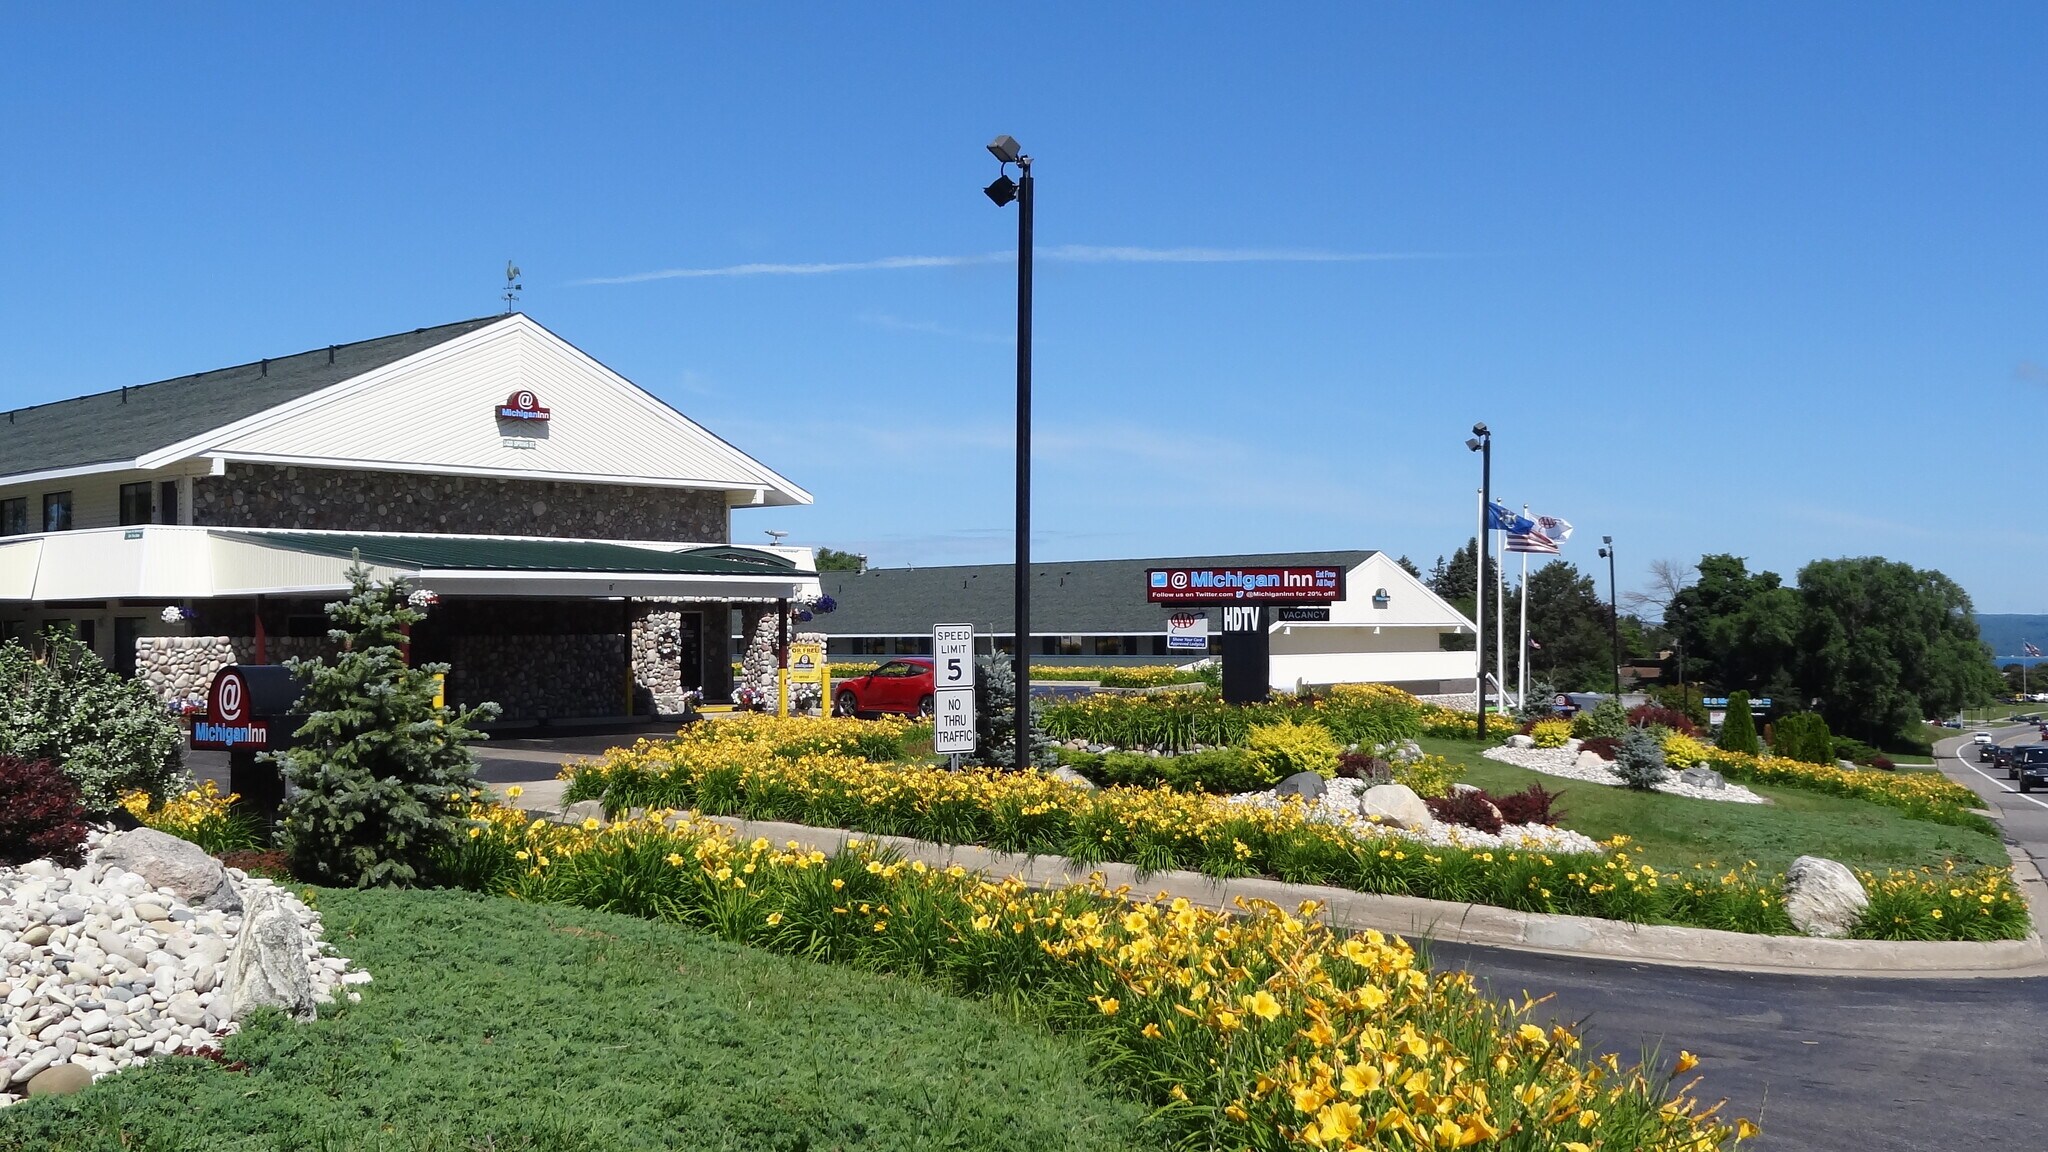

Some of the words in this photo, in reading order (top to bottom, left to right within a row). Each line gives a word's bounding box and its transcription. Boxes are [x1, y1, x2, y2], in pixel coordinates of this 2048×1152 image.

[518, 392, 533, 410] @
[502, 408, 549, 419] MichiganInn
[1171, 571, 1187, 589] @
[1191, 571, 1280, 590] Michigan
[1283, 570, 1313, 587] Inn
[1315, 570, 1324, 578] Eat
[1325, 570, 1336, 578] Free
[1223, 606, 1260, 632] HDTV
[1282, 611, 1326, 619] VACANCY
[937, 631, 970, 641] SPEED
[941, 644, 967, 654] LIMIT
[947, 658, 962, 681] 5
[219, 674, 241, 721] @
[948, 698, 961, 711] NO
[944, 715, 967, 726] THRU
[195, 722, 267, 746] MichiganInn
[938, 729, 973, 743] TRAFFIC
